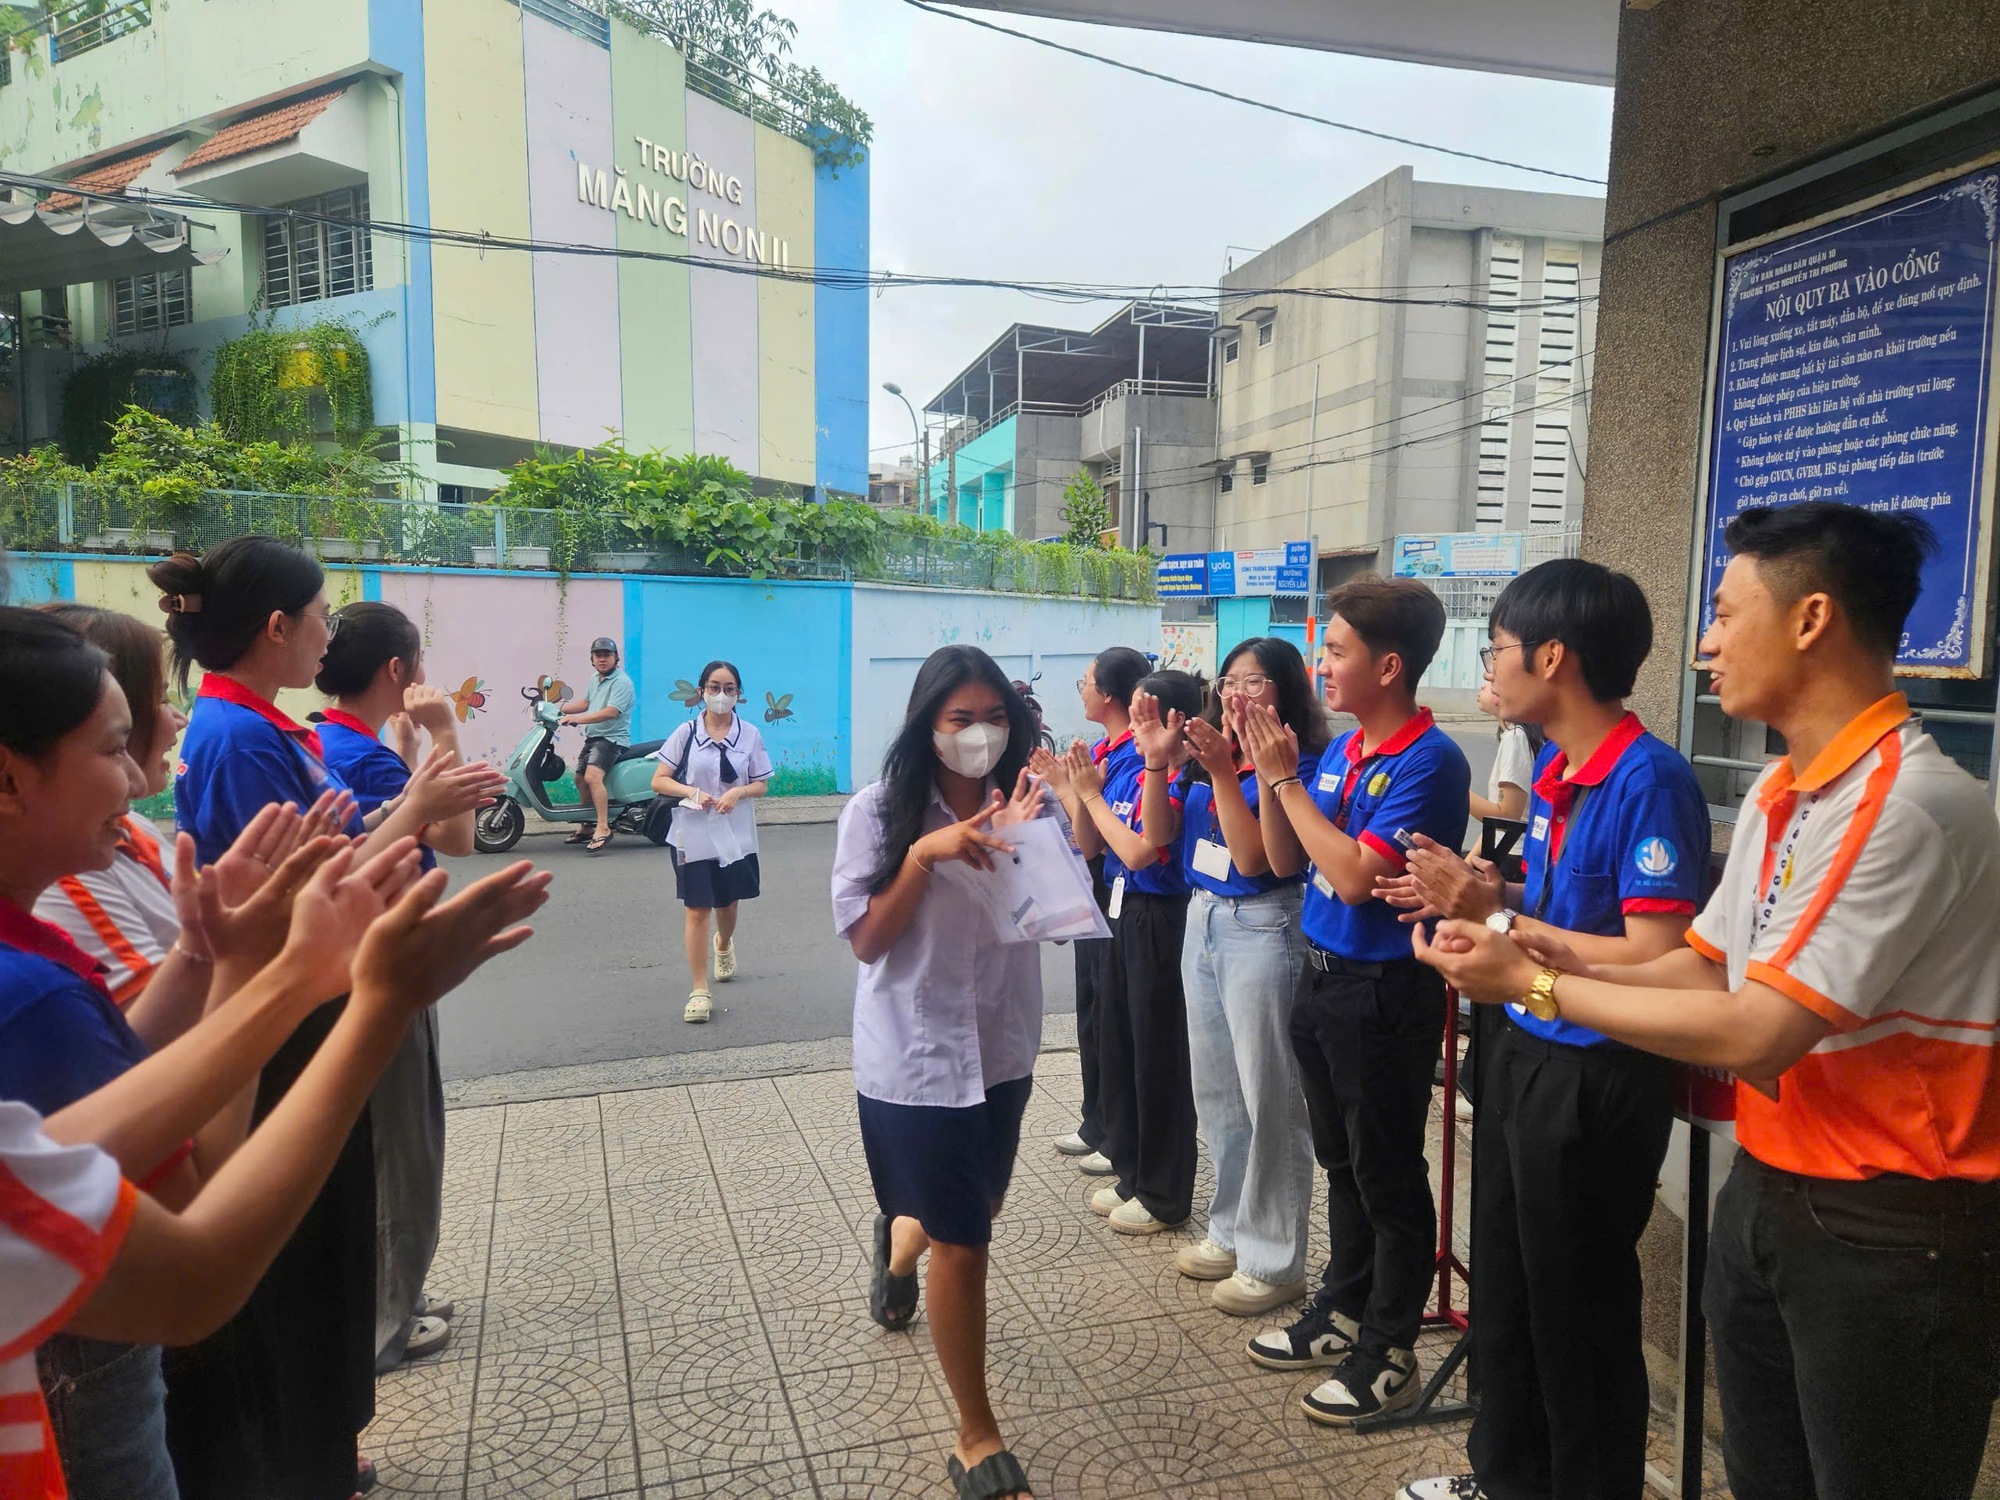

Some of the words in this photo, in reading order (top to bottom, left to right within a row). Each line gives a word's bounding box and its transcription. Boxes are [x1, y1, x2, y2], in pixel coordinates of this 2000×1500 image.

[634, 135, 742, 204] TRƯỜNG
[577, 161, 687, 237] MĂNG
[698, 207, 765, 264] NON
[771, 236, 787, 271] II
[1740, 285, 1763, 300] TRƯỜNG
[1765, 280, 1780, 292] THCS
[1781, 270, 1807, 287] NGUYỄN
[1821, 259, 1848, 275] PHƯƠNG
[1751, 273, 1759, 284] ỦY
[1761, 270, 1773, 281] BAN
[1775, 264, 1792, 276] NHÂN
[1794, 258, 1807, 270] DÂN
[1809, 252, 1826, 266] QUẬN
[1829, 248, 1836, 258] 10
[1765, 294, 1791, 322] NỘI
[1795, 286, 1826, 316] QUY
[1829, 279, 1850, 303] RA
[1855, 266, 1888, 295] VÀO
[1892, 248, 1940, 284] CỔNG
[1732, 342, 1738, 352] 1.
[1740, 337, 1751, 350] Vui
[1753, 335, 1769, 349] lòng
[1770, 326, 1793, 342] xuống
[1794, 327, 1805, 336] xe,
[1807, 316, 1818, 332] tắt
[1820, 314, 1838, 329] máy,
[1857, 305, 1870, 320] bộ,
[1884, 301, 1894, 312] xe
[1897, 293, 1918, 308] đúng
[1921, 285, 1935, 302] nơi
[1938, 284, 1956, 300] quy
[1957, 273, 1981, 293] định.
[1729, 381, 1734, 392] 3.
[1736, 377, 1759, 390] Không
[1761, 372, 1778, 385] được
[1780, 367, 1800, 380] mang
[1802, 359, 1815, 375] bất
[1829, 355, 1839, 369] tài
[1857, 349, 1872, 362] nào
[1874, 348, 1884, 358] ra
[1886, 339, 1905, 356] khỏi
[1907, 334, 1937, 350] trường
[1940, 325, 1956, 343] nếu
[1730, 361, 1736, 372] 2.
[1738, 357, 1759, 370] Trang
[1761, 352, 1778, 368] phục
[1780, 346, 1793, 362] lịch
[1809, 340, 1821, 353] kín
[1841, 332, 1856, 344] văn
[1858, 324, 1881, 340] minh.
[1726, 420, 1732, 431] 4.
[1733, 416, 1748, 431] Quý
[1749, 412, 1771, 427] khách
[1773, 410, 1782, 422] và
[1784, 404, 1806, 420] PHHS
[1808, 402, 1821, 415] khi
[1823, 399, 1838, 412] liên
[1840, 396, 1850, 410] hệ
[1852, 392, 1865, 406] với
[1867, 389, 1882, 404] nhà
[1885, 385, 1914, 400] trường
[1916, 379, 1930, 393] vui
[1932, 376, 1955, 391] lòng:
[1733, 398, 1756, 410] không
[1757, 393, 1775, 406] được
[1776, 387, 1795, 404] phép
[1797, 383, 1810, 396] của
[1812, 380, 1829, 394] hiệu
[1741, 455, 1764, 468] Không
[1766, 452, 1784, 465] được
[1785, 450, 1794, 462] tự
[1795, 447, 1800, 462] ý
[1802, 445, 1816, 458] vào
[1818, 442, 1843, 458] phòng
[1844, 438, 1863, 452] hoặc
[1865, 434, 1879, 447] các
[1881, 431, 1909, 448] phòng
[1910, 425, 1931, 440] chức
[1933, 423, 1958, 437] năng.
[1743, 435, 1757, 449] Gặp
[1759, 432, 1772, 445] bảo
[1774, 431, 1782, 443] vệ
[1796, 426, 1814, 439] được
[1860, 417, 1869, 428] cụ
[1872, 408, 1888, 424] thể.
[1755, 474, 1768, 488] gặp
[1770, 469, 1794, 483] GVCN,
[1796, 464, 1822, 479] GVBM,
[1825, 462, 1837, 475] HS
[1839, 460, 1850, 475] tại
[1851, 458, 1878, 475] phòng
[1879, 452, 1896, 469] tiếp
[1898, 449, 1914, 465] dân
[1917, 446, 1944, 463] (trước
[1719, 518, 1724, 528] 5.
[1871, 500, 1888, 512] trên
[1891, 495, 1899, 510] lề
[1901, 495, 1929, 510] đường
[1930, 492, 1951, 509] phía
[1737, 495, 1749, 509] giờ
[1750, 494, 1764, 508] học,
[1766, 491, 1778, 506] giờ
[1779, 494, 1787, 502] ra
[1789, 487, 1807, 500] chơi,
[1809, 486, 1822, 501] giờ
[1823, 488, 1832, 497] ra
[1211, 559, 1231, 572] yola
[1283, 569, 1302, 577] ĐƯỜNG
